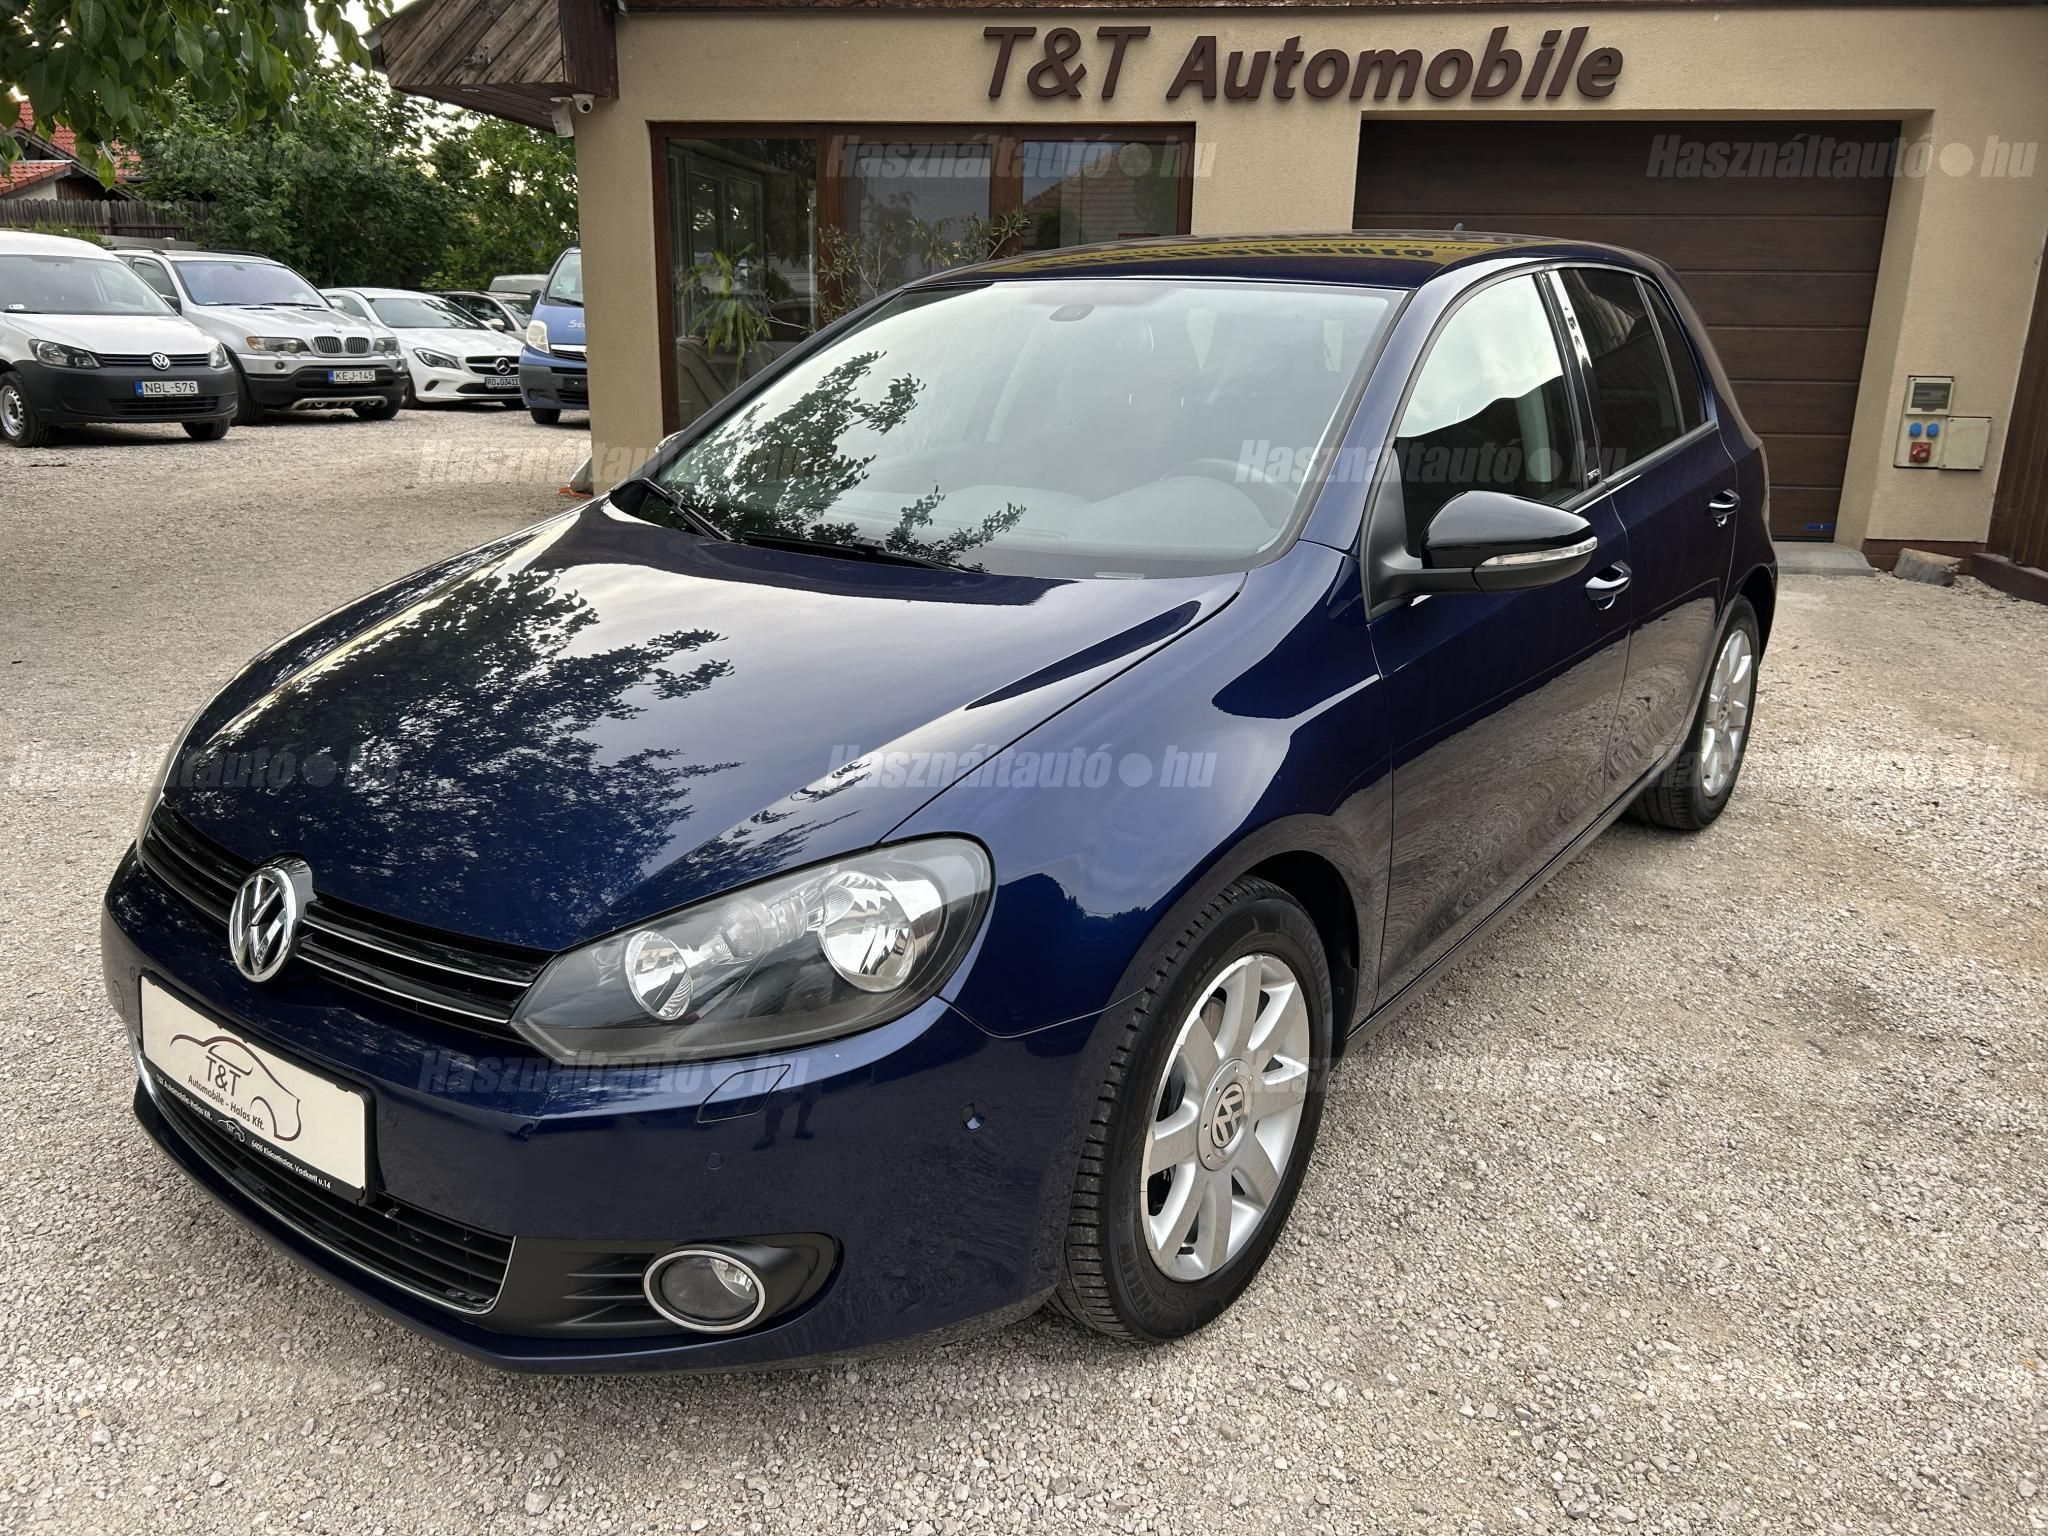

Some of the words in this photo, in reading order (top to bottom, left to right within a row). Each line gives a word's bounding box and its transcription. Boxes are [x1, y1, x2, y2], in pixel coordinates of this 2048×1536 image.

[983, 26, 1151, 99] T&T
[1165, 26, 1624, 100] Automobile
[145, 382, 196, 394] NBL-576
[335, 370, 375, 382] KEJ-145
[206, 1055, 242, 1096] T&T
[188, 1074, 225, 1106] Automobile
[230, 1101, 251, 1123] Halas
[252, 1115, 265, 1131] Kft.
